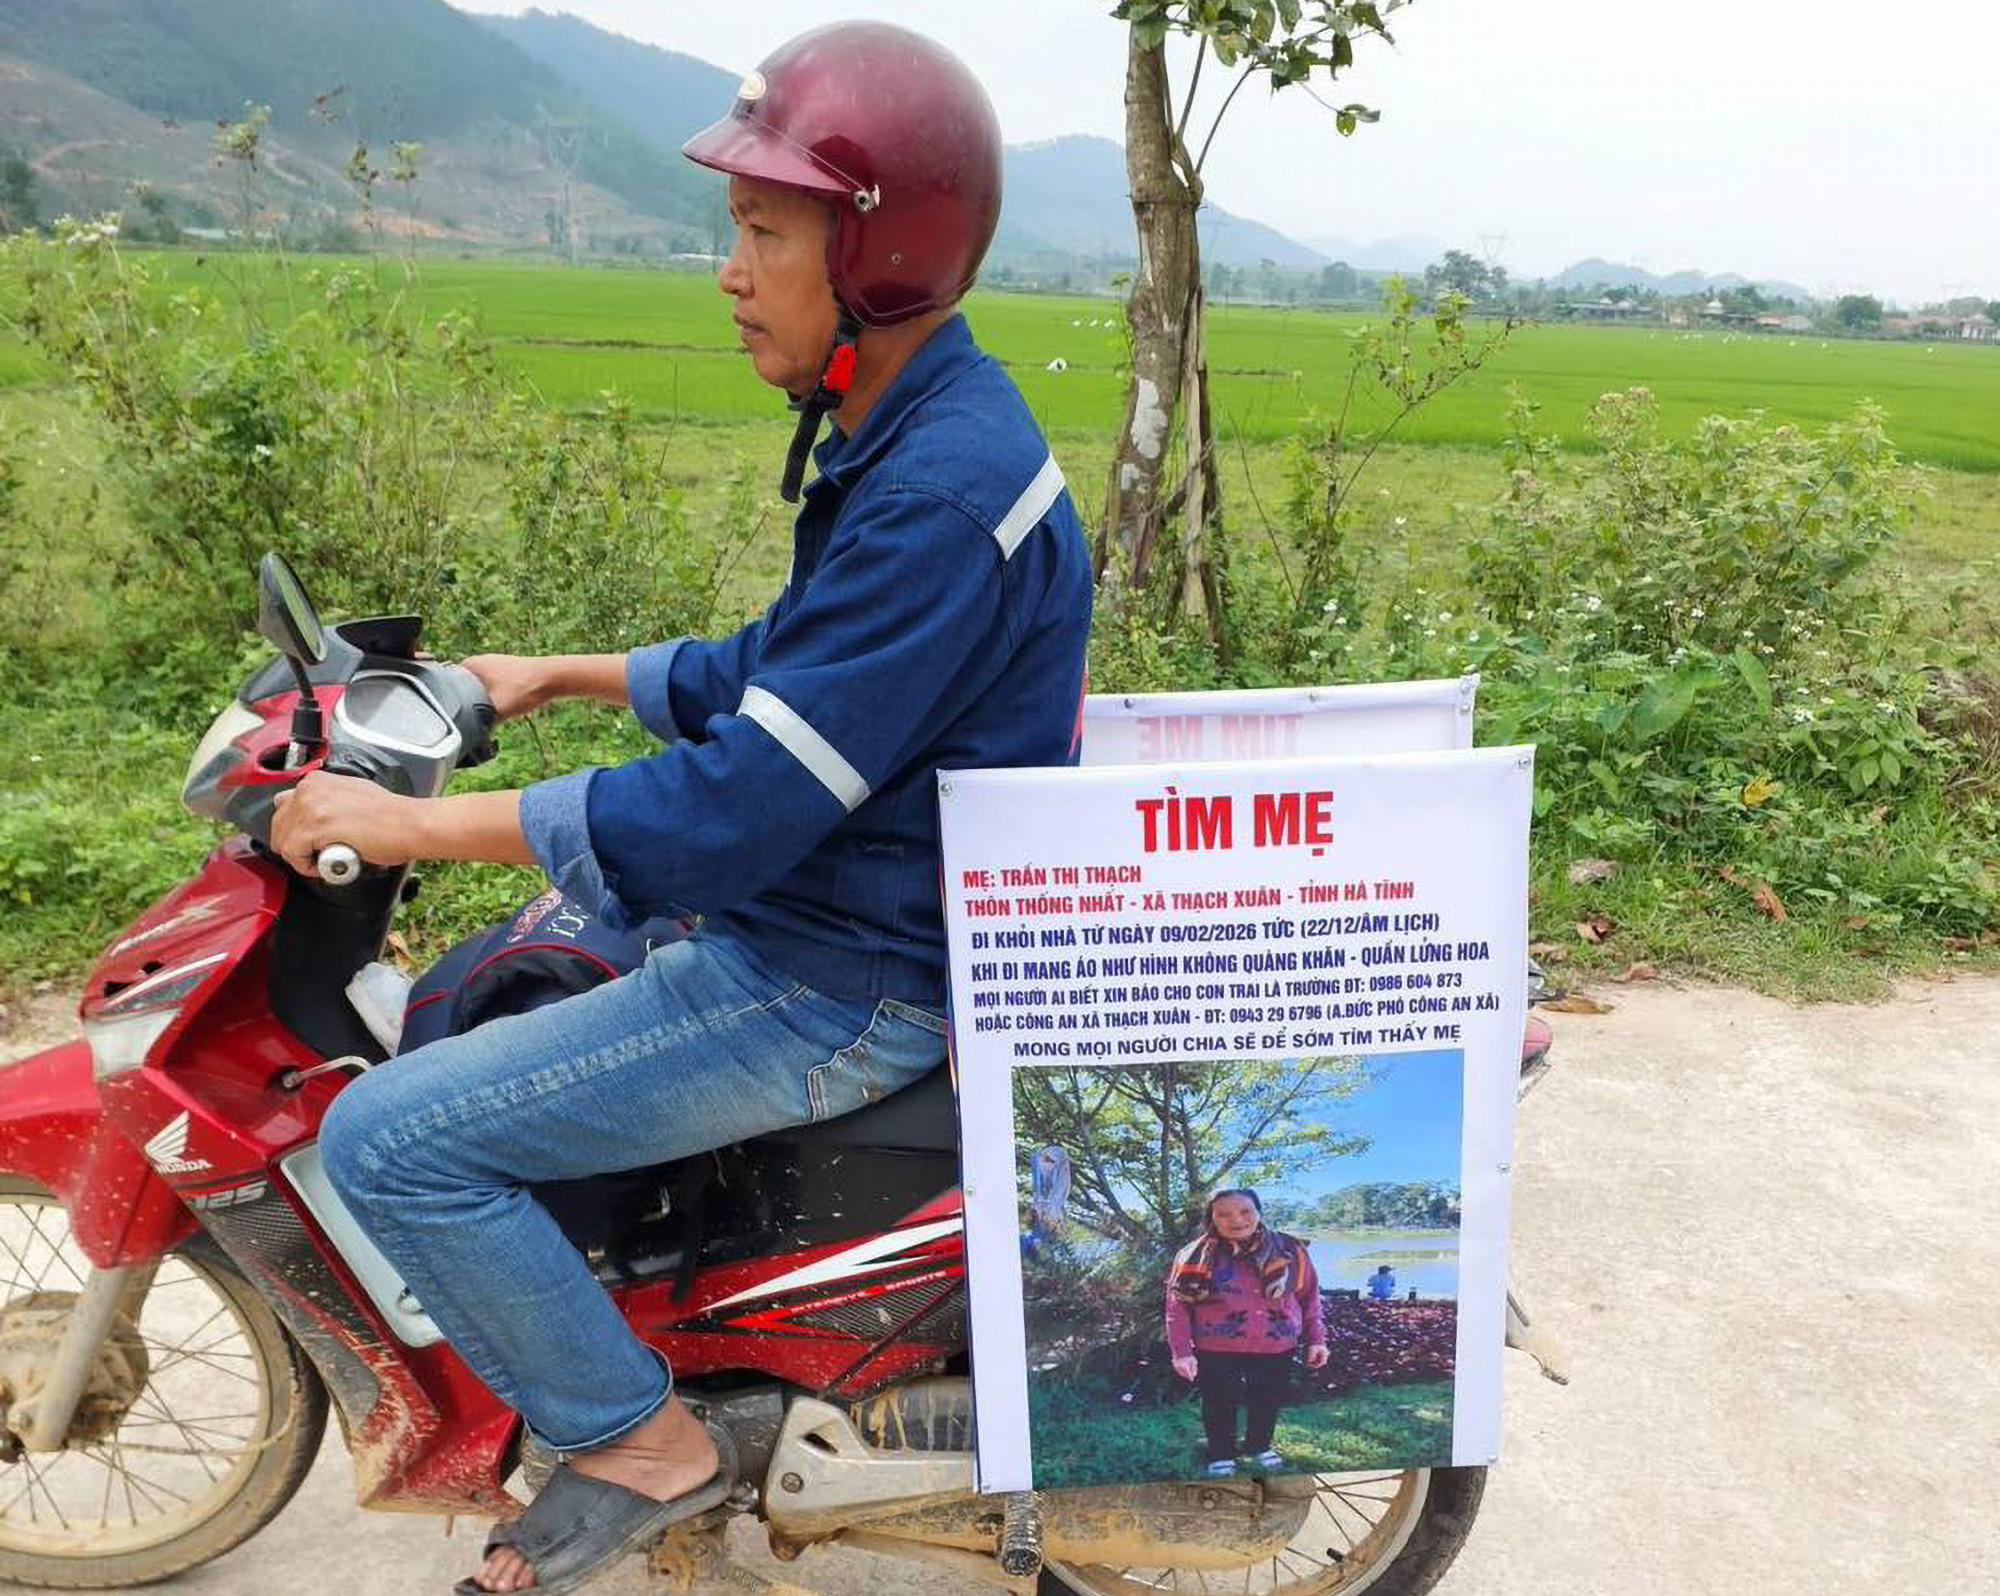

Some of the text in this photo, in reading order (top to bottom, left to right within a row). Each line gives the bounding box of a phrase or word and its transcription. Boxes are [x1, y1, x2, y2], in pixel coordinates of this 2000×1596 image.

[1136, 786, 1333, 856] TÌM MẸ
[963, 871, 995, 891] MẸ:
[1052, 867, 1079, 887] THỊ
[1086, 865, 1141, 887] THẠCH
[965, 898, 1010, 917] THÔN
[1016, 891, 1073, 915] THỐNG
[1080, 889, 1124, 913] NHẤT
[1172, 892, 1227, 913] THẠCH
[1234, 886, 1281, 908] XUÂN
[972, 932, 989, 949] ĐI
[995, 924, 1035, 948] KHỎI
[1041, 926, 1076, 947] NHÀ
[1109, 926, 1155, 944] NGÀY
[1160, 923, 1257, 942] 09/02/2026
[1263, 916, 1295, 939] TỨC
[1301, 913, 1388, 939] (22/12/ÂM
[1395, 913, 1439, 935] LỊCH)
[972, 963, 997, 981] KHI
[1003, 962, 1018, 980] ĐI
[1024, 961, 1071, 980] MANG
[1077, 956, 1097, 977] ÁO
[1103, 957, 1136, 976] NHƯ
[1183, 951, 1238, 974] KHÔNG
[1302, 946, 1345, 969] KHĂN
[1458, 941, 1489, 961] HOA
[974, 992, 1000, 1010] MỌI
[1052, 991, 1065, 1005] AI
[1104, 988, 1127, 1004] XIN
[1164, 985, 1191, 1000] CHO
[1197, 985, 1224, 999] CON
[1229, 984, 1259, 999] TRAI
[1265, 979, 1280, 997] LÀ
[1407, 975, 1432, 990] 604
[1437, 973, 1462, 988] 873
[1058, 1015, 1077, 1029] AN
[1105, 1011, 1148, 1030] THẠCH
[1153, 1007, 1190, 1025] XUÂN
[1268, 1007, 1284, 1022] 29
[1289, 1005, 1322, 1021] 6796
[1452, 996, 1471, 1011] AN
[1014, 1041, 1070, 1057] MONG
[1077, 1041, 1112, 1060] MỌI
[1118, 1036, 1176, 1055] NGƯỜI
[1183, 1037, 1227, 1052] CHIA
[1434, 1024, 1461, 1043] MẸ
